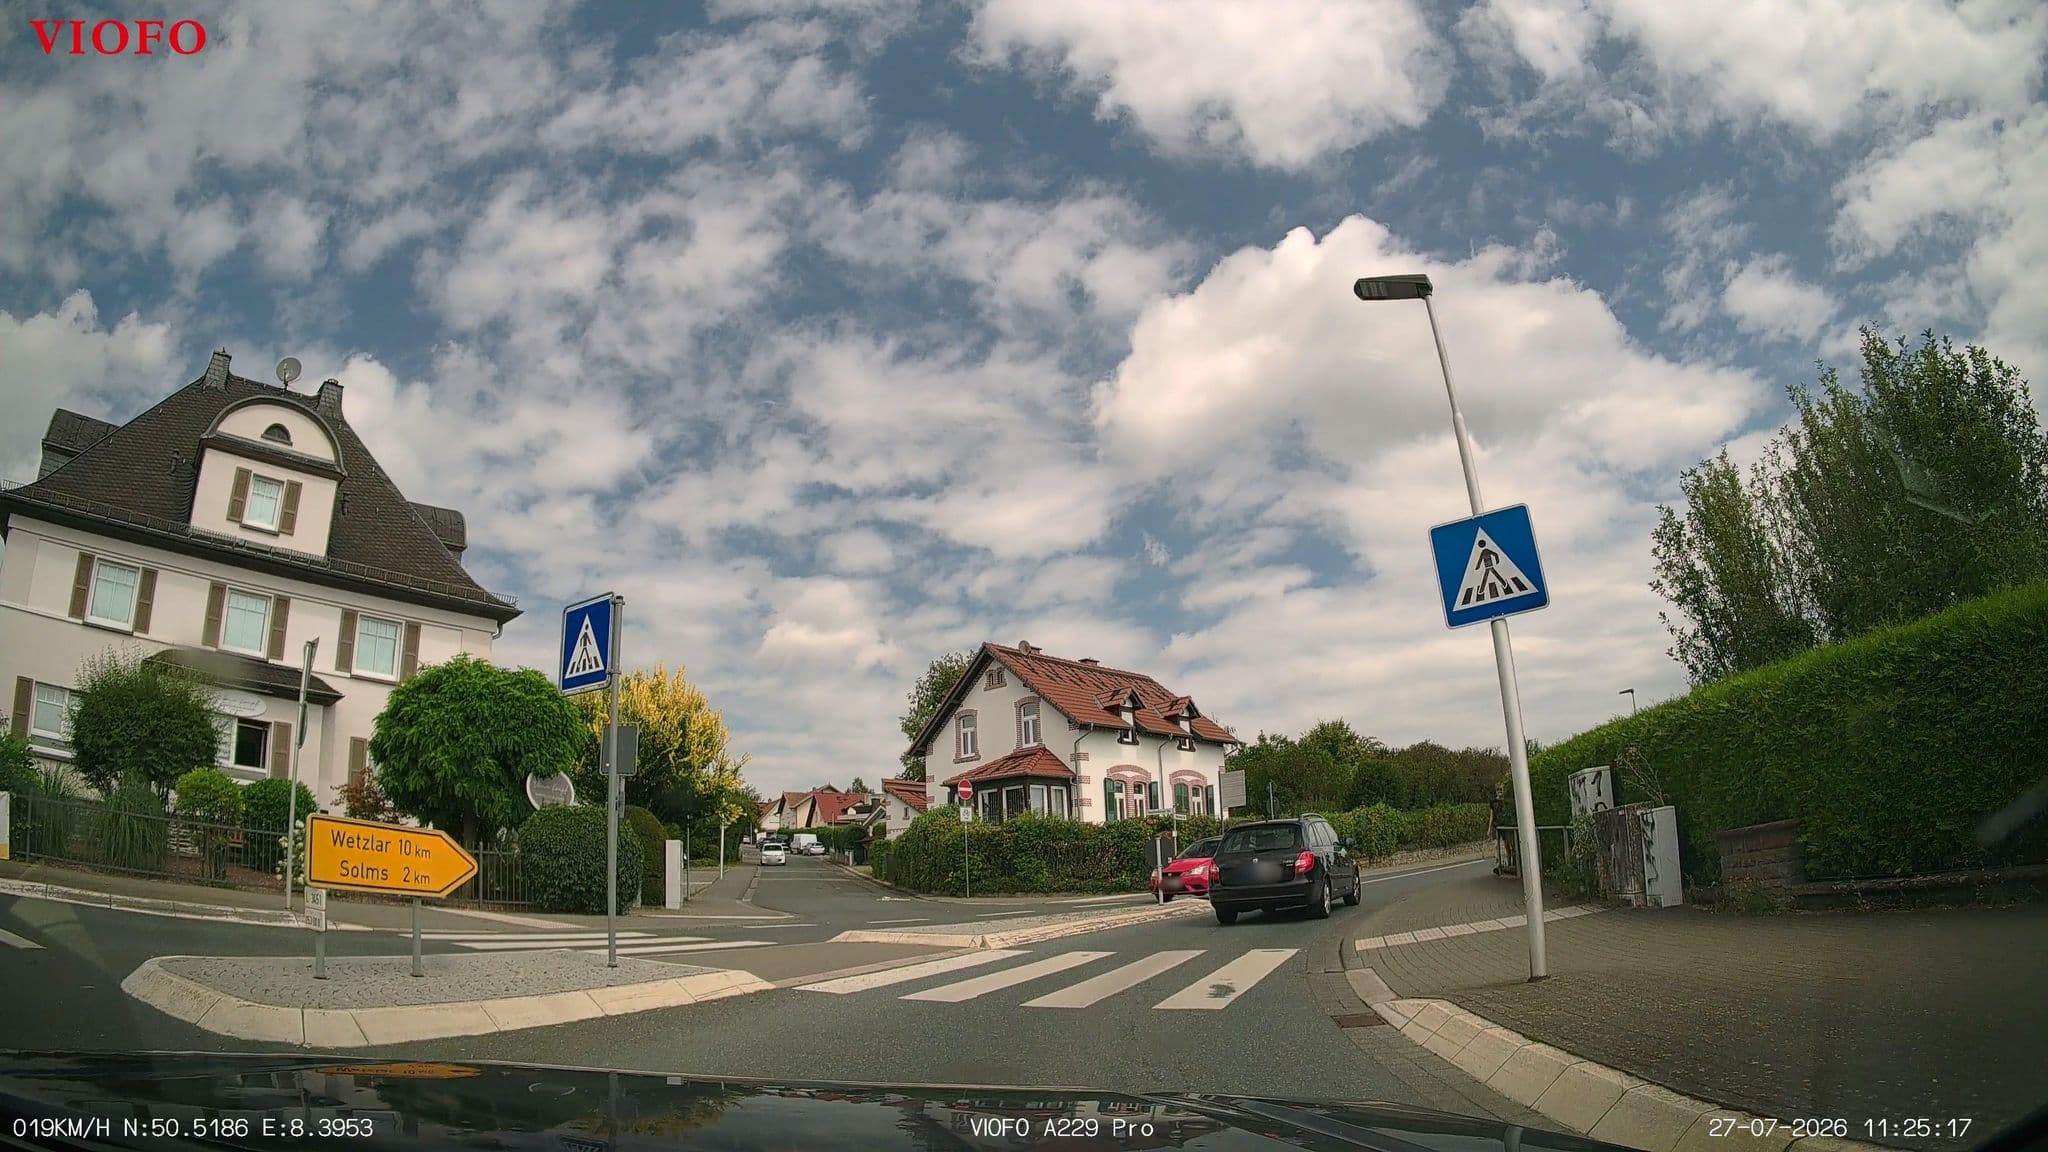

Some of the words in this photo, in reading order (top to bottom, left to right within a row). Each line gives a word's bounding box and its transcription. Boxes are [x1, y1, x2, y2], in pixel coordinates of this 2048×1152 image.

[331, 829, 391, 853] Wetzlar
[399, 839, 412, 856] 10
[415, 846, 431, 859] km
[340, 860, 389, 881] Solms
[403, 867, 411, 883] 2
[414, 872, 430, 885] km
